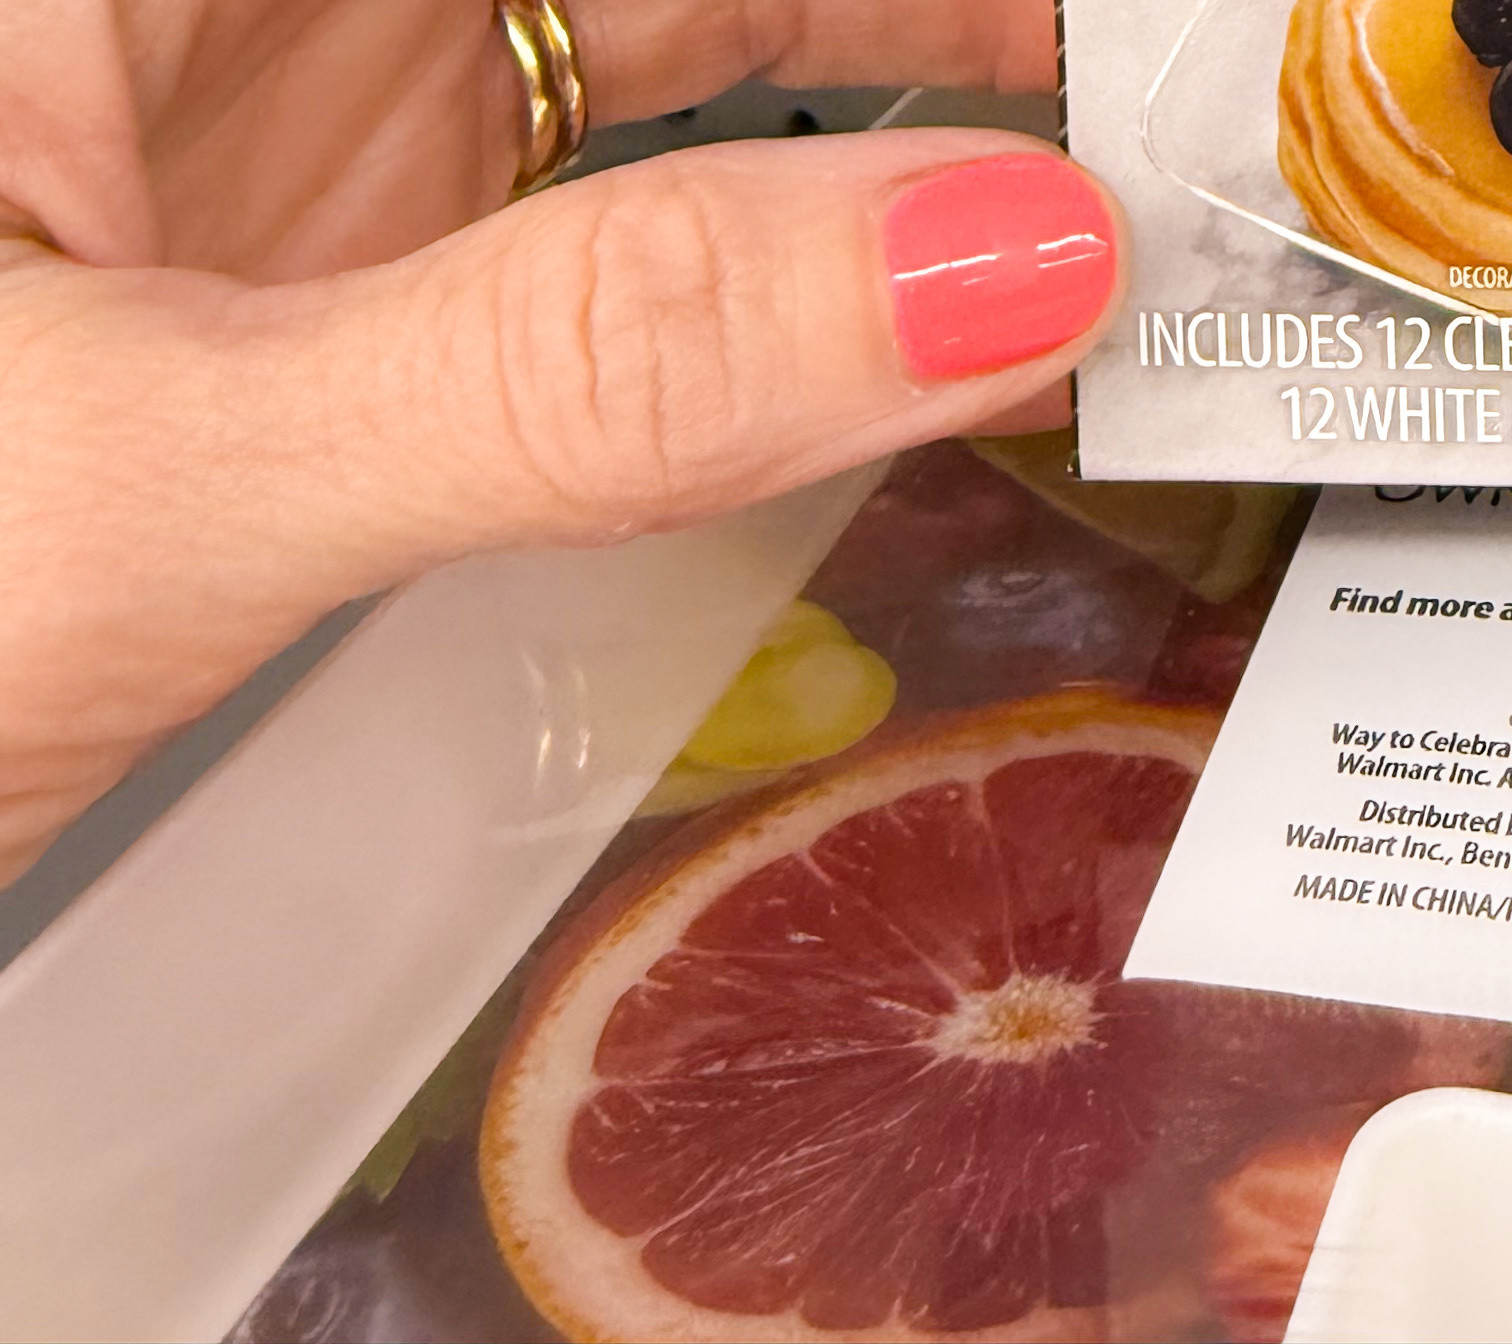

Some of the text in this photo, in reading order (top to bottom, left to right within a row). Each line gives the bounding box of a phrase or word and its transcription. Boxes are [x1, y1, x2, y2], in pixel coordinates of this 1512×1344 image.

[1139, 312, 1363, 369] INCLUDES
[1376, 317, 1433, 370] 12
[1280, 386, 1338, 440] 12
[1345, 386, 1503, 442] WHITE
[1330, 587, 1403, 614] Find
[1405, 595, 1494, 620] more
[1332, 723, 1384, 751] Way
[1389, 730, 1415, 750] to
[1337, 752, 1444, 783] Walmart
[1448, 763, 1492, 787] Inc.
[1359, 799, 1501, 836] Distributed
[1285, 824, 1396, 857] Walmart
[1401, 835, 1454, 866] Inc.,
[1293, 874, 1375, 905] MADE
[1378, 883, 1407, 908] IN
